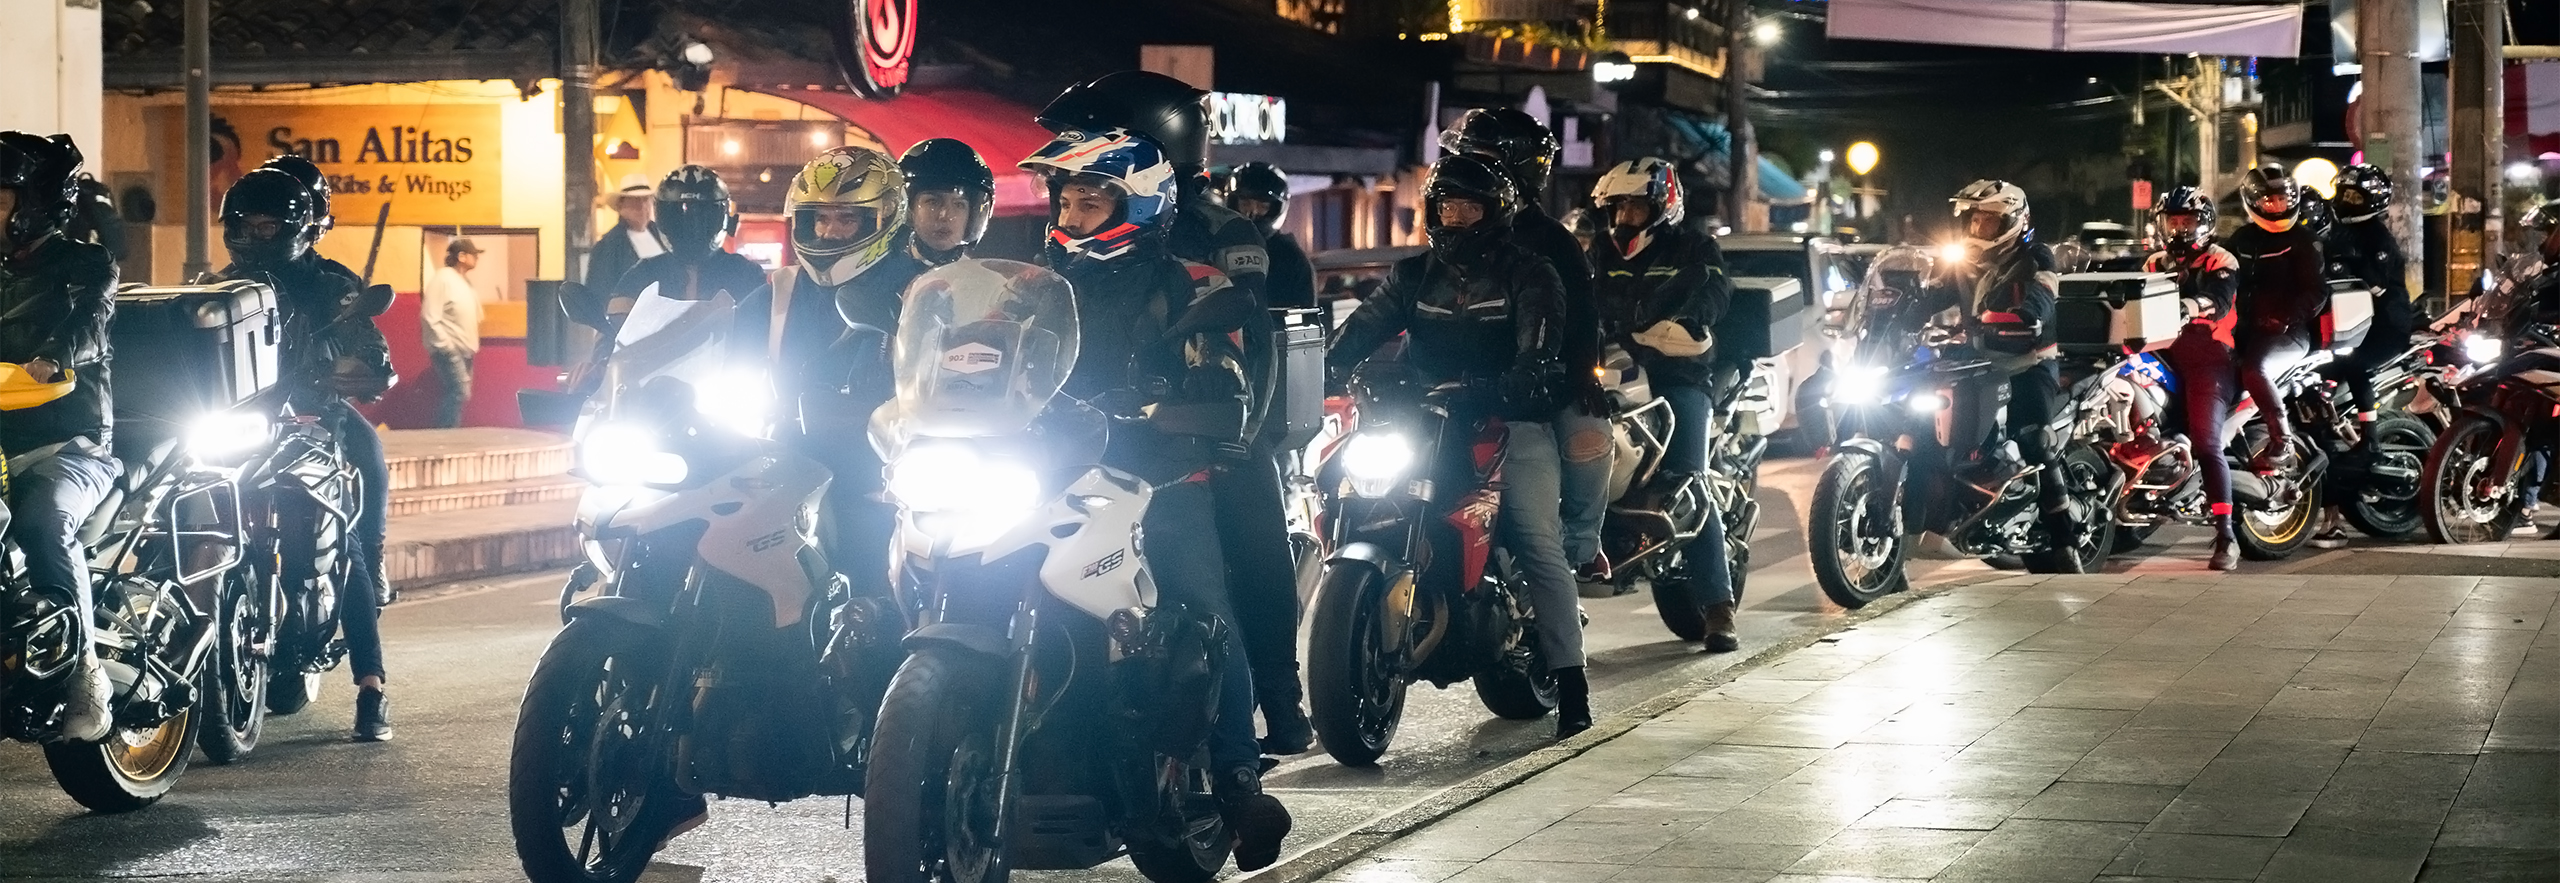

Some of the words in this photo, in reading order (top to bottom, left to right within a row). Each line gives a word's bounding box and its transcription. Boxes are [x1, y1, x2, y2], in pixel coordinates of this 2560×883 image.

[268, 126, 342, 164] San
[355, 126, 473, 164] Alitas
[329, 174, 371, 195] Ribs
[377, 174, 396, 194] &
[405, 174, 472, 202] Wings
[948, 354, 966, 362] 902
